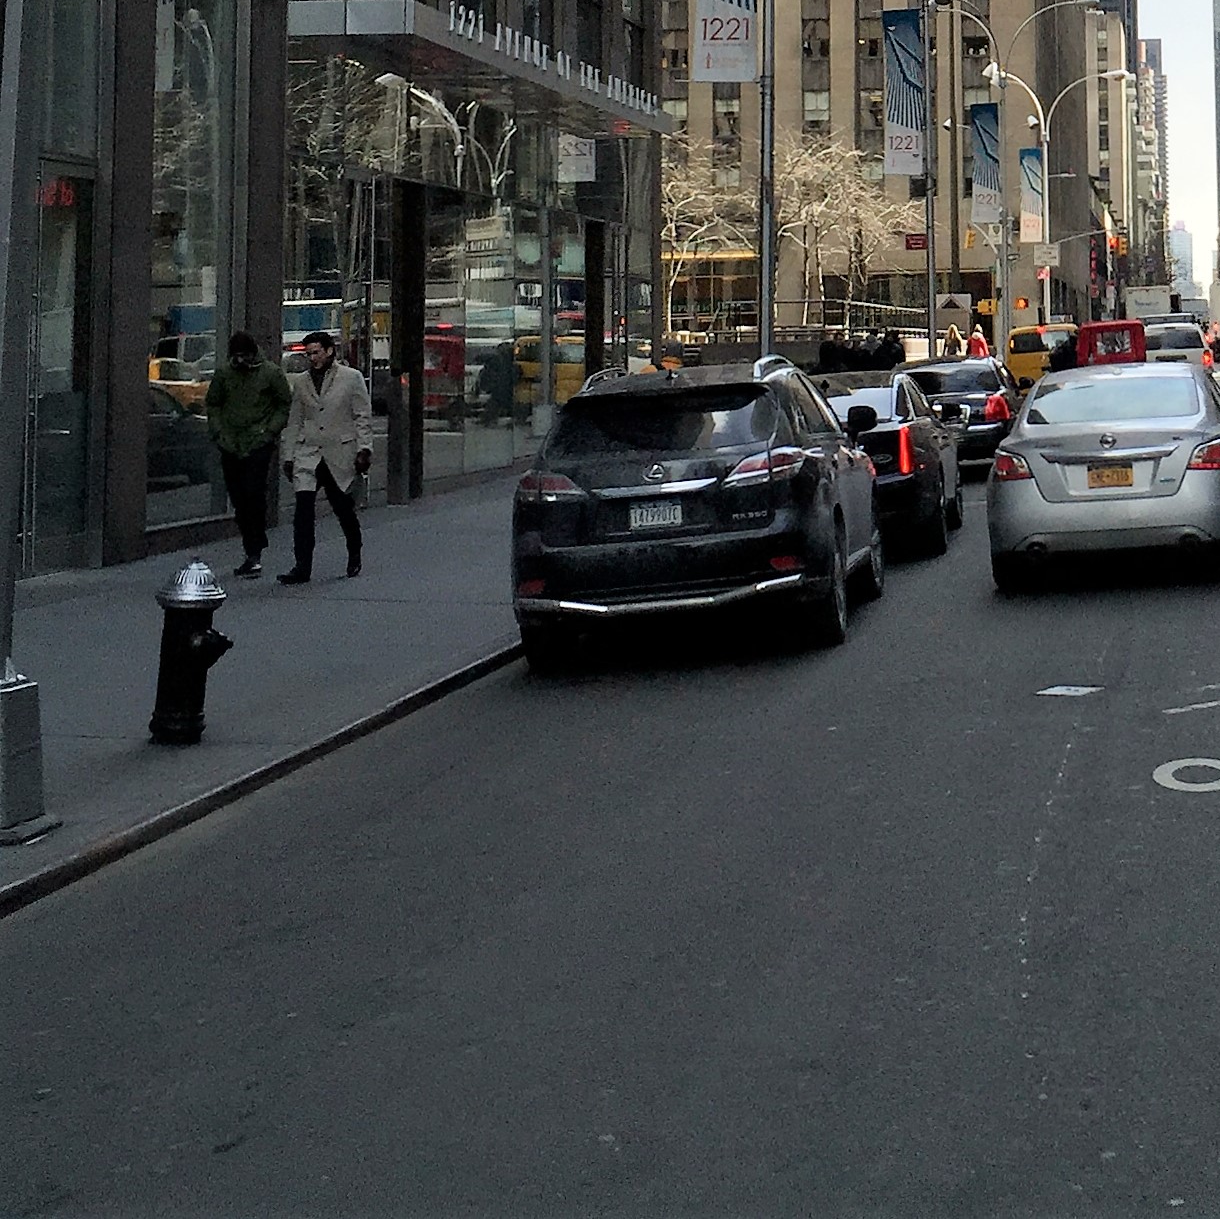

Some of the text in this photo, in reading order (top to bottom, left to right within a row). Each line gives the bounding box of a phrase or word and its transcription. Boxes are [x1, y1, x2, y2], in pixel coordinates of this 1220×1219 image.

[450, 1, 484, 44] 1221
[701, 17, 749, 41] 1221
[889, 135, 919, 150] 1221
